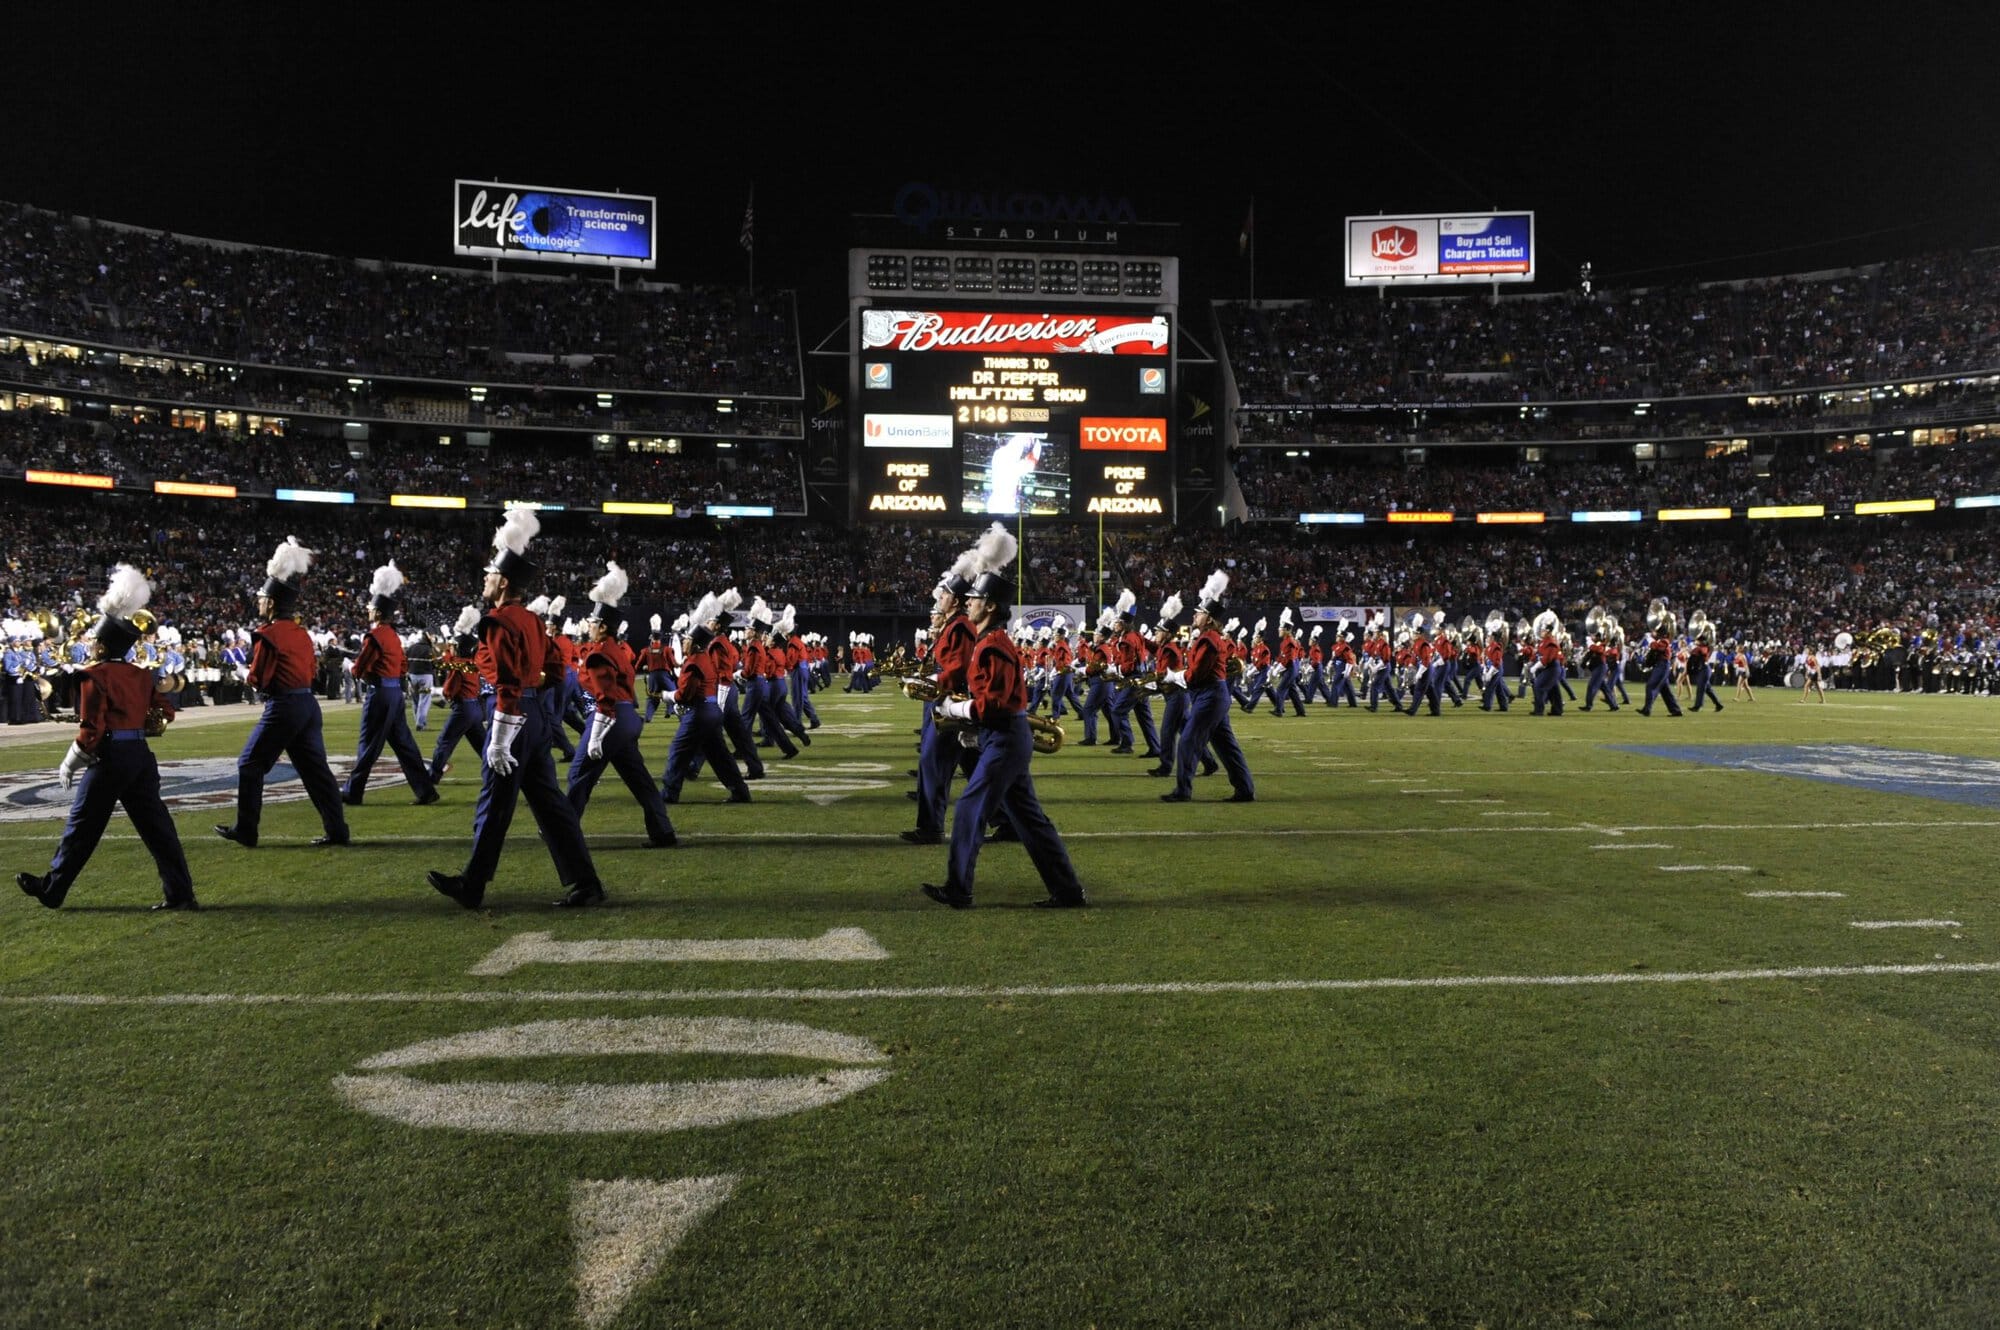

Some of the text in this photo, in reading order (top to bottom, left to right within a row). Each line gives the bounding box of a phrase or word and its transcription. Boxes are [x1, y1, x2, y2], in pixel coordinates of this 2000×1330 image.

[460, 190, 527, 246] life
[567, 206, 645, 224] Transforming
[584, 220, 628, 232] science
[946, 227, 1118, 241] STADIUM
[1373, 229, 1416, 257] Jack
[1456, 235, 1512, 248] Buy and Sell
[1444, 246, 1524, 260] Chargers Tickets!
[892, 314, 1097, 351] Budweiser
[983, 357, 1050, 370] THANKS TO
[972, 370, 1059, 386] DR PEPPER
[949, 386, 1087, 402] HALFTIME SHOW
[887, 426, 951, 437] UnionBank
[1084, 426, 1162, 443] TOYOTA
[887, 464, 929, 477] PRIDE
[1104, 466, 1146, 479] PRIDE
[898, 479, 918, 492] OF
[1115, 482, 1135, 495] OF
[869, 494, 947, 511] ARIZONA
[1086, 497, 1162, 513] ARIZONA
